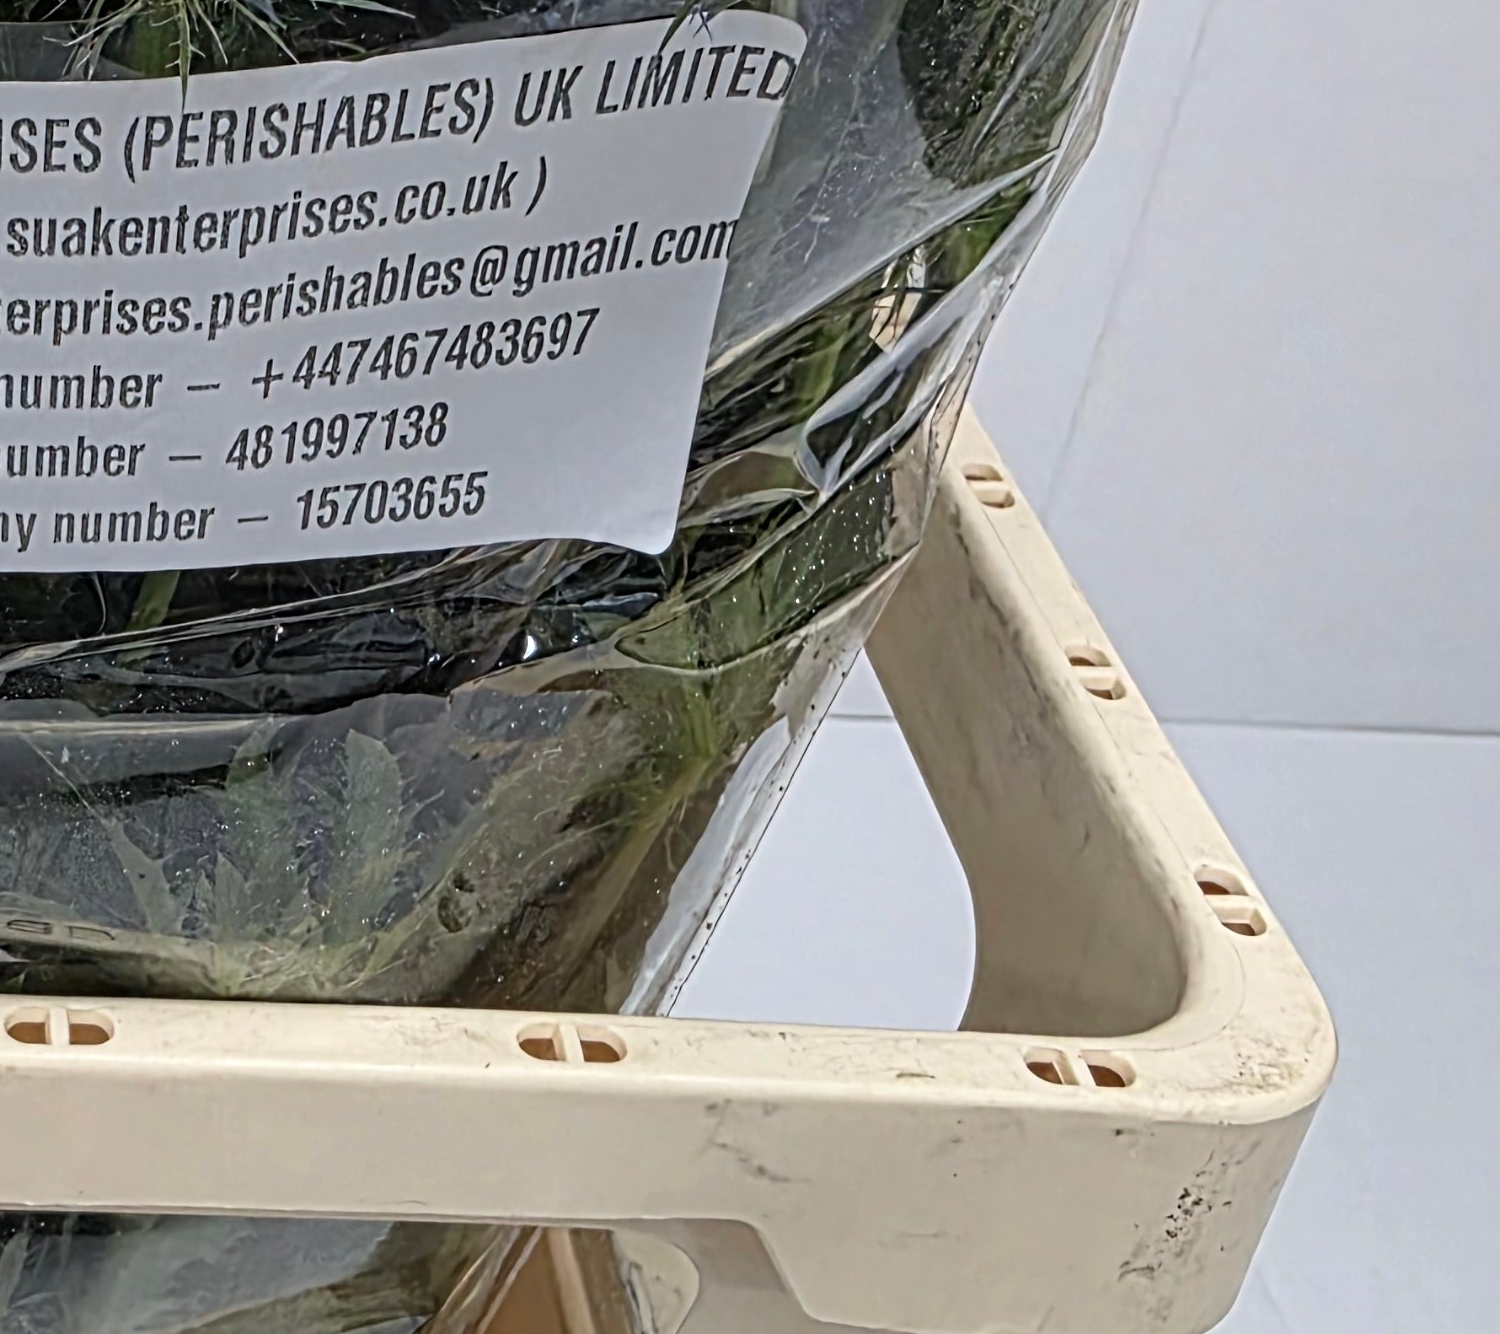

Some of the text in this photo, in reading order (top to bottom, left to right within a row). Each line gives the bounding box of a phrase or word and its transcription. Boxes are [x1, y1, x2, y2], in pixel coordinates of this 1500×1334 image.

[123, 76, 495, 184] (PERISHABLES)
[514, 64, 585, 128] UK
[595, 44, 798, 114] LIMITED
[250, 307, 601, 400] +447467483697
[224, 401, 450, 471] 481997138
[52, 500, 216, 545] number
[296, 470, 489, 531] 15703655
